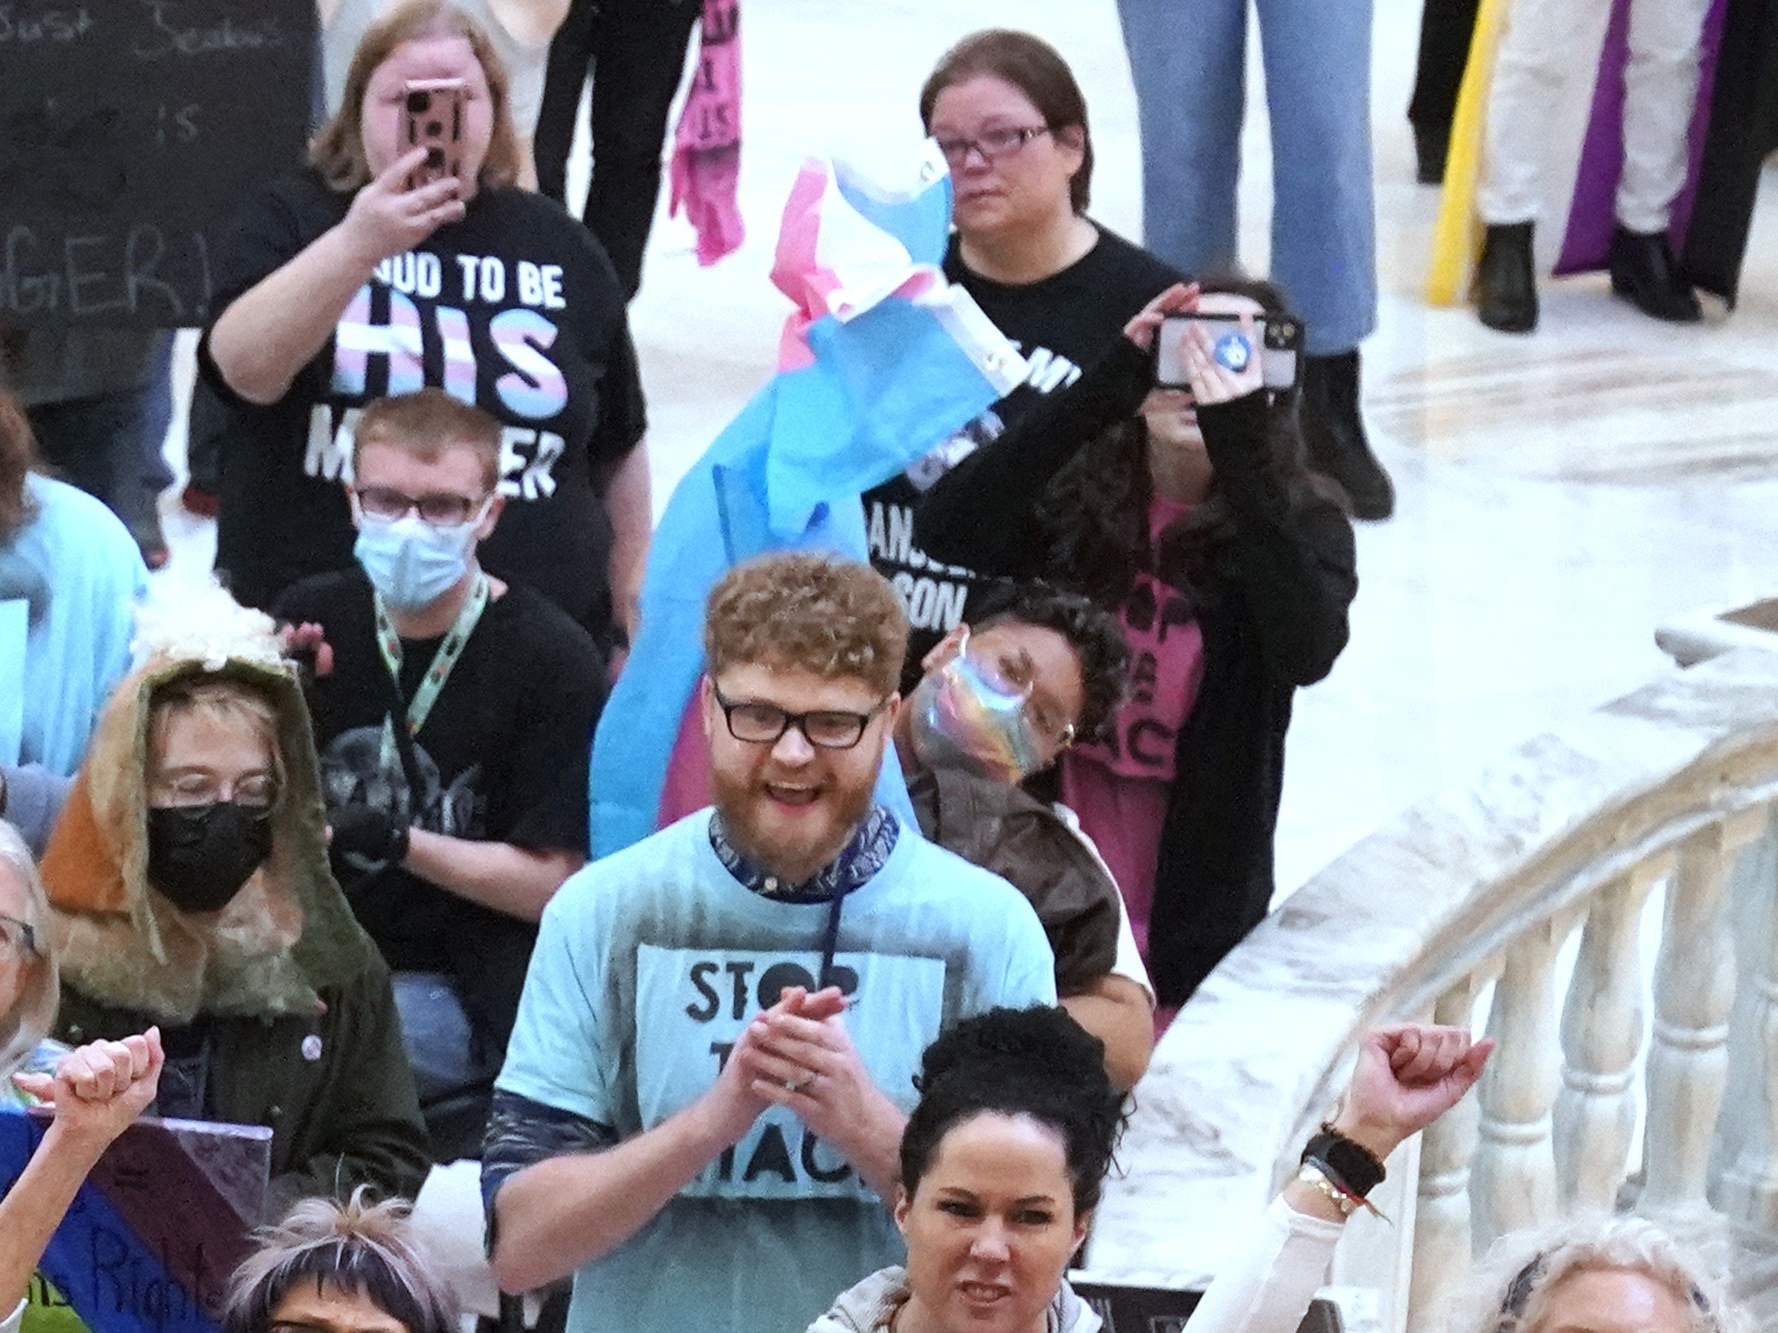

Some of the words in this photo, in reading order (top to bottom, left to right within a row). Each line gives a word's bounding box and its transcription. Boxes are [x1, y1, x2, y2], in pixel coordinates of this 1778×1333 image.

[456, 253, 506, 302] TO
[517, 260, 566, 309] BE
[329, 284, 568, 419] HIS
[304, 403, 566, 500] MER
